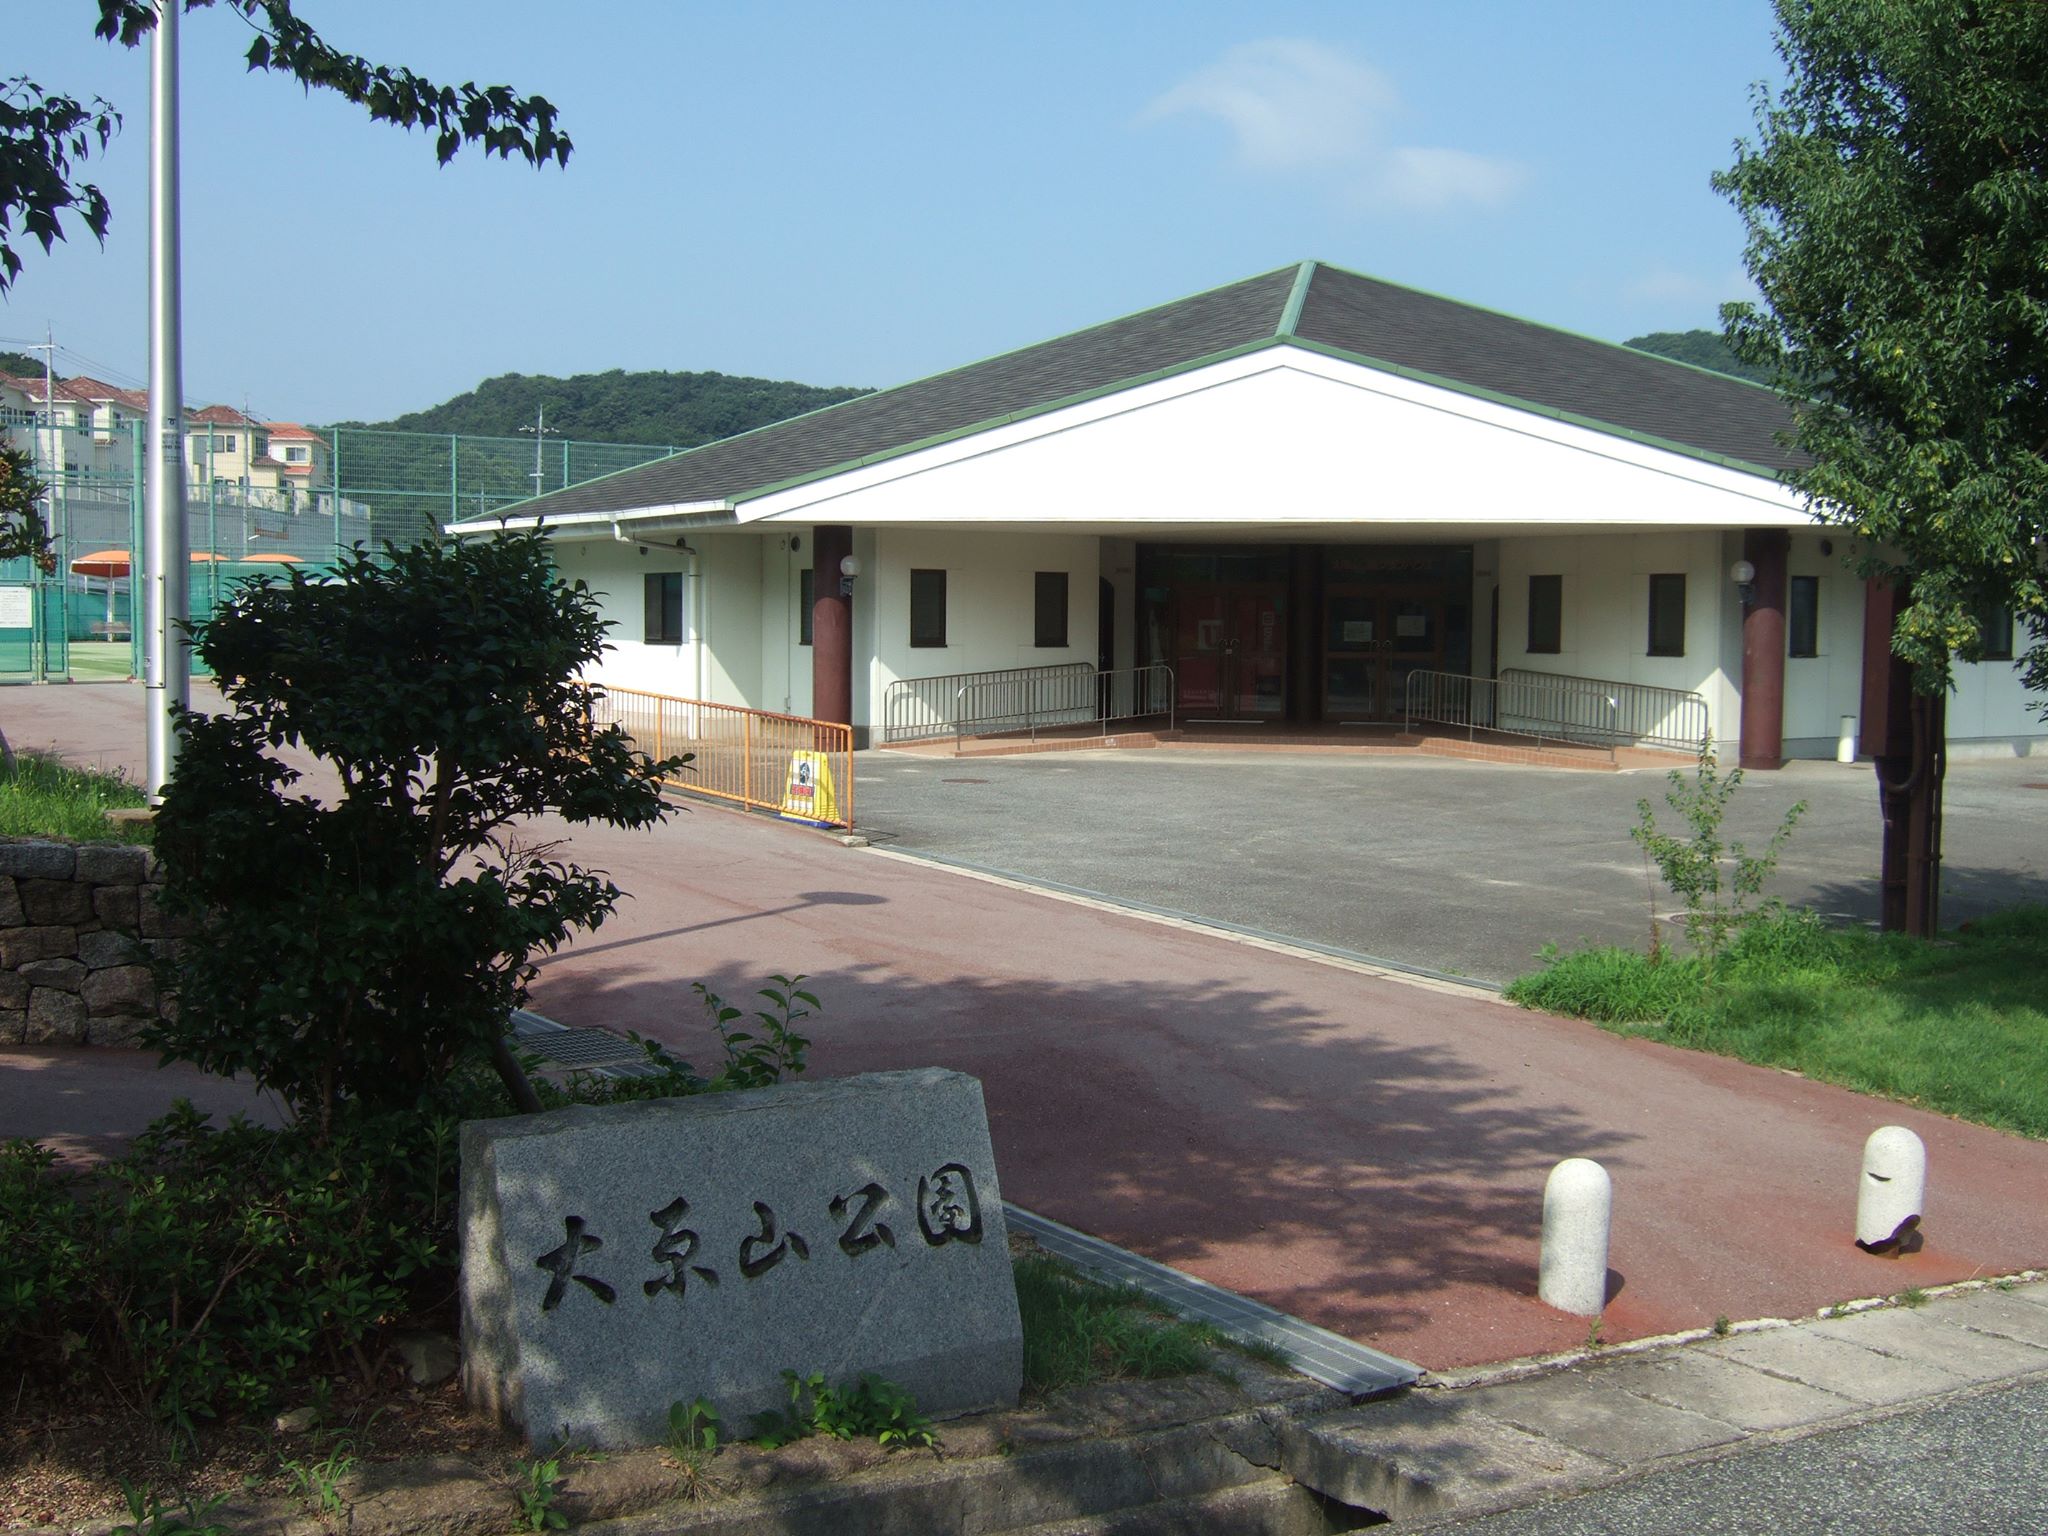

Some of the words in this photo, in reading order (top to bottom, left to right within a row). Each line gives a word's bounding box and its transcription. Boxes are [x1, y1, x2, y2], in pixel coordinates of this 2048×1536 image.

[536, 1162, 984, 1311] 大原山公園
